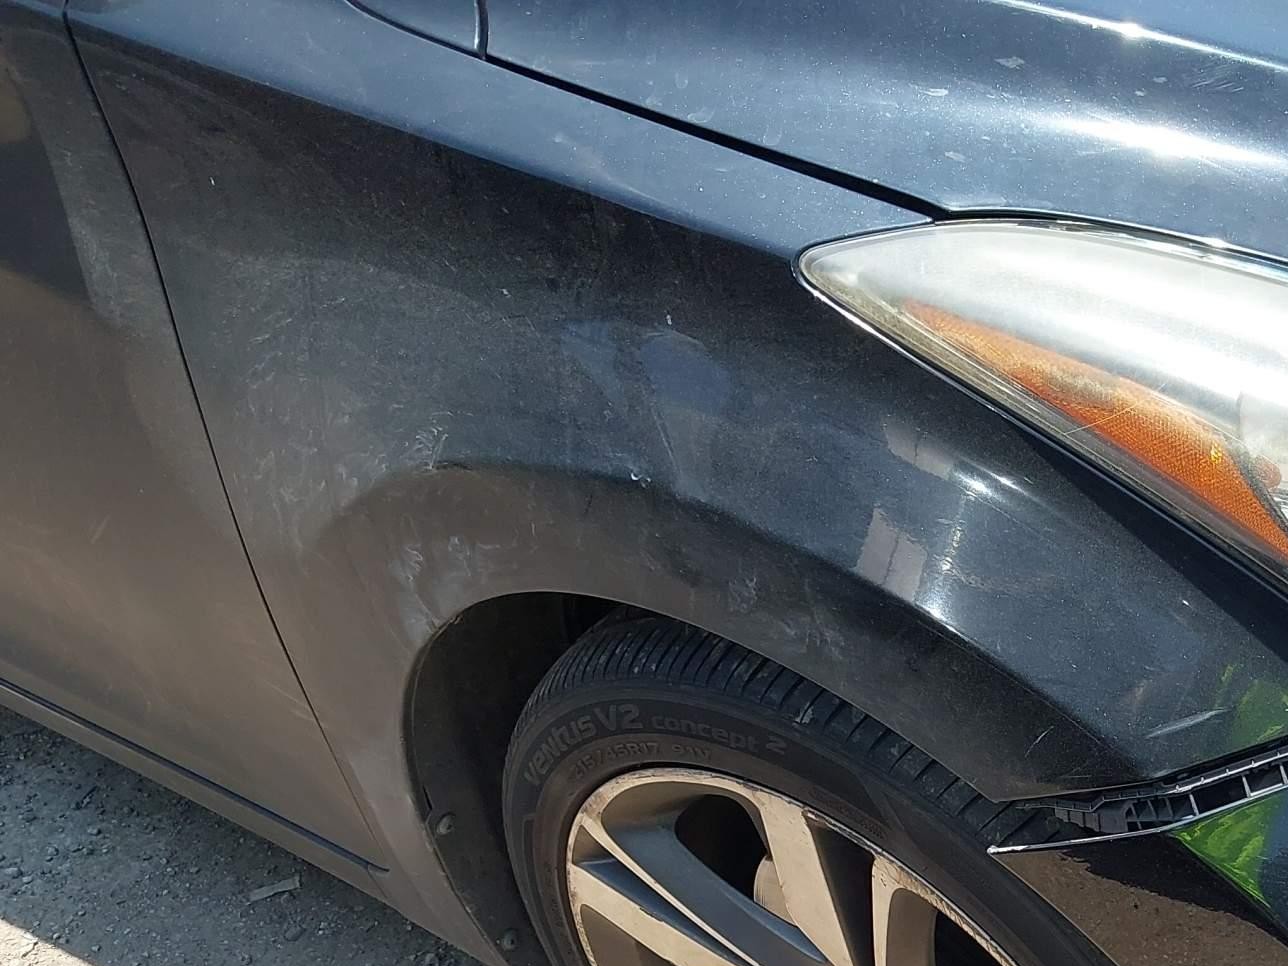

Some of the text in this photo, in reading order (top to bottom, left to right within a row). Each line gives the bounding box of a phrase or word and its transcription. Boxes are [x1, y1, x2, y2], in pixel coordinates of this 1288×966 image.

[593, 703, 643, 732] V2
[651, 716, 759, 753] concept
[765, 735, 787, 755] 2
